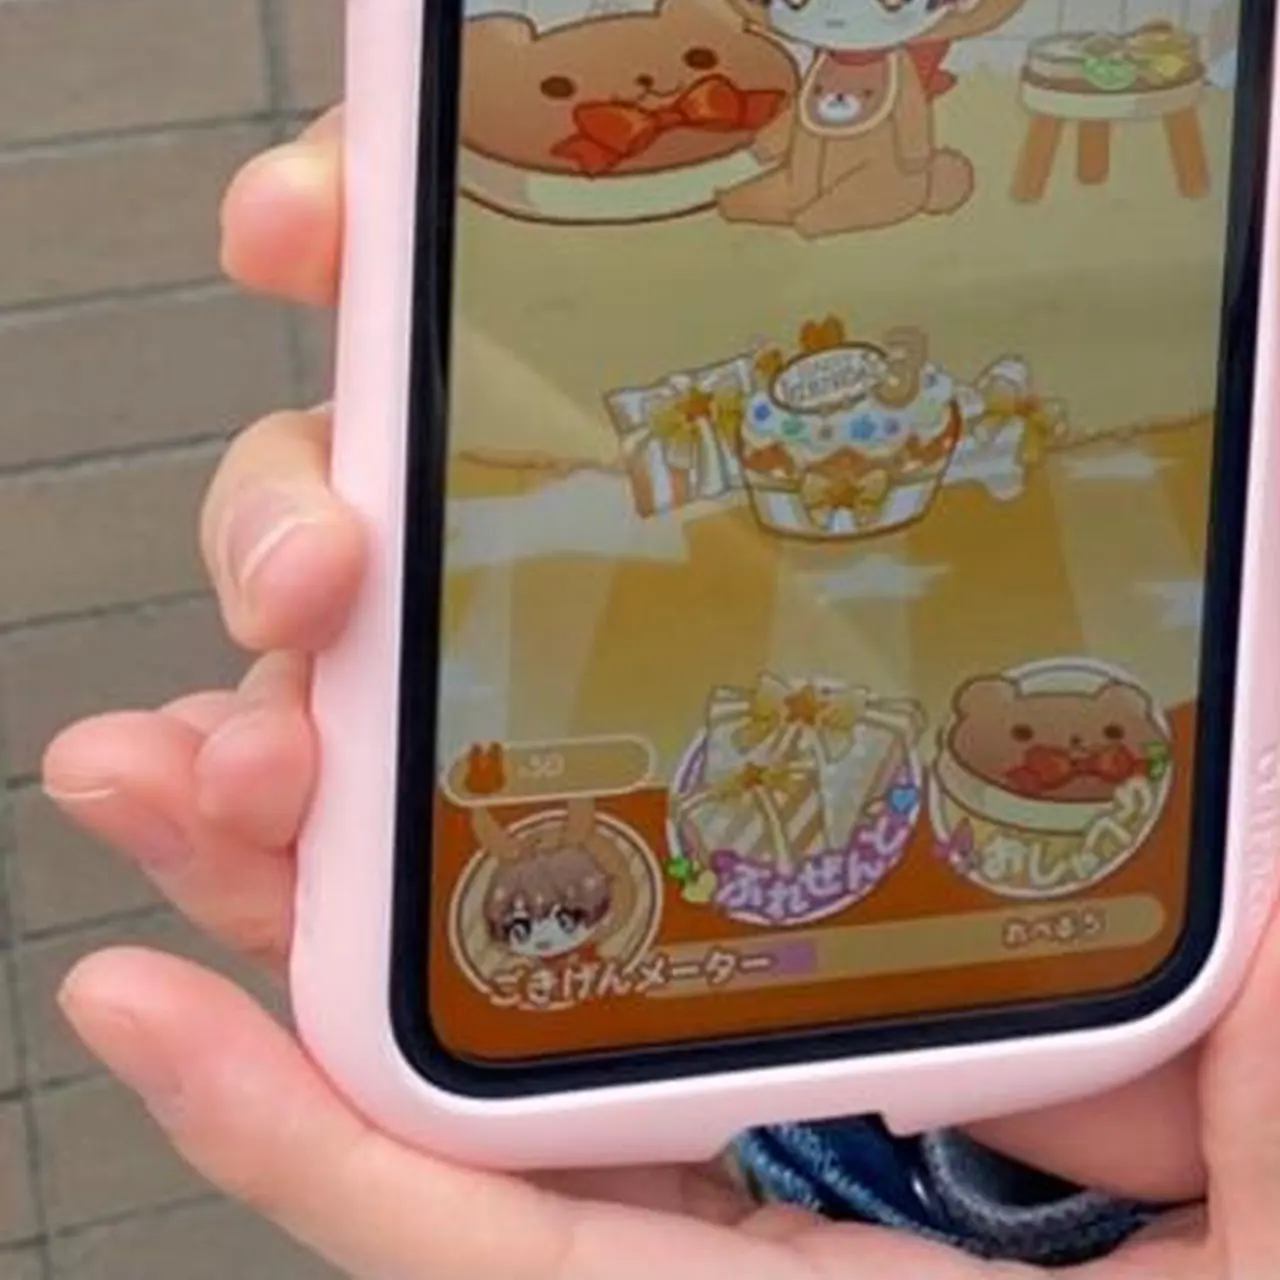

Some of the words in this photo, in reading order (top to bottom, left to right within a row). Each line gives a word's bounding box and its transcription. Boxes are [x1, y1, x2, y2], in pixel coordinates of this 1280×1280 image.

[489, 952, 774, 1007] ごきげんメーター
